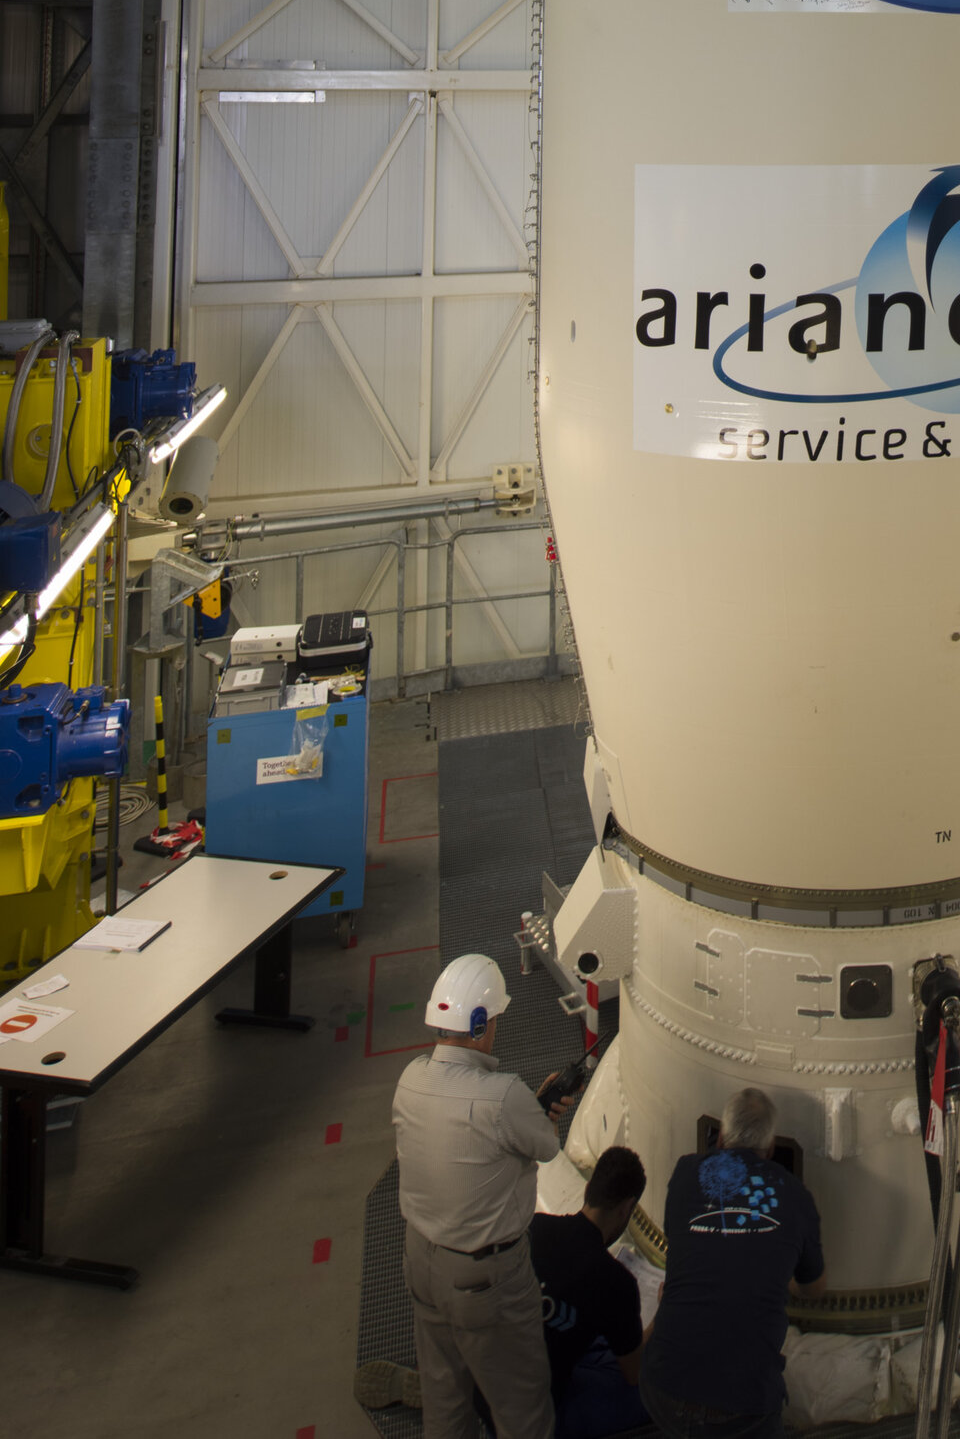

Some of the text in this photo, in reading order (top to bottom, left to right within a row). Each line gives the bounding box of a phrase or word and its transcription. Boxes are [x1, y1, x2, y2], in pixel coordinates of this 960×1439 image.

[719, 417, 907, 461] service
[923, 420, 951, 457] &
[935, 829, 951, 843] TN
